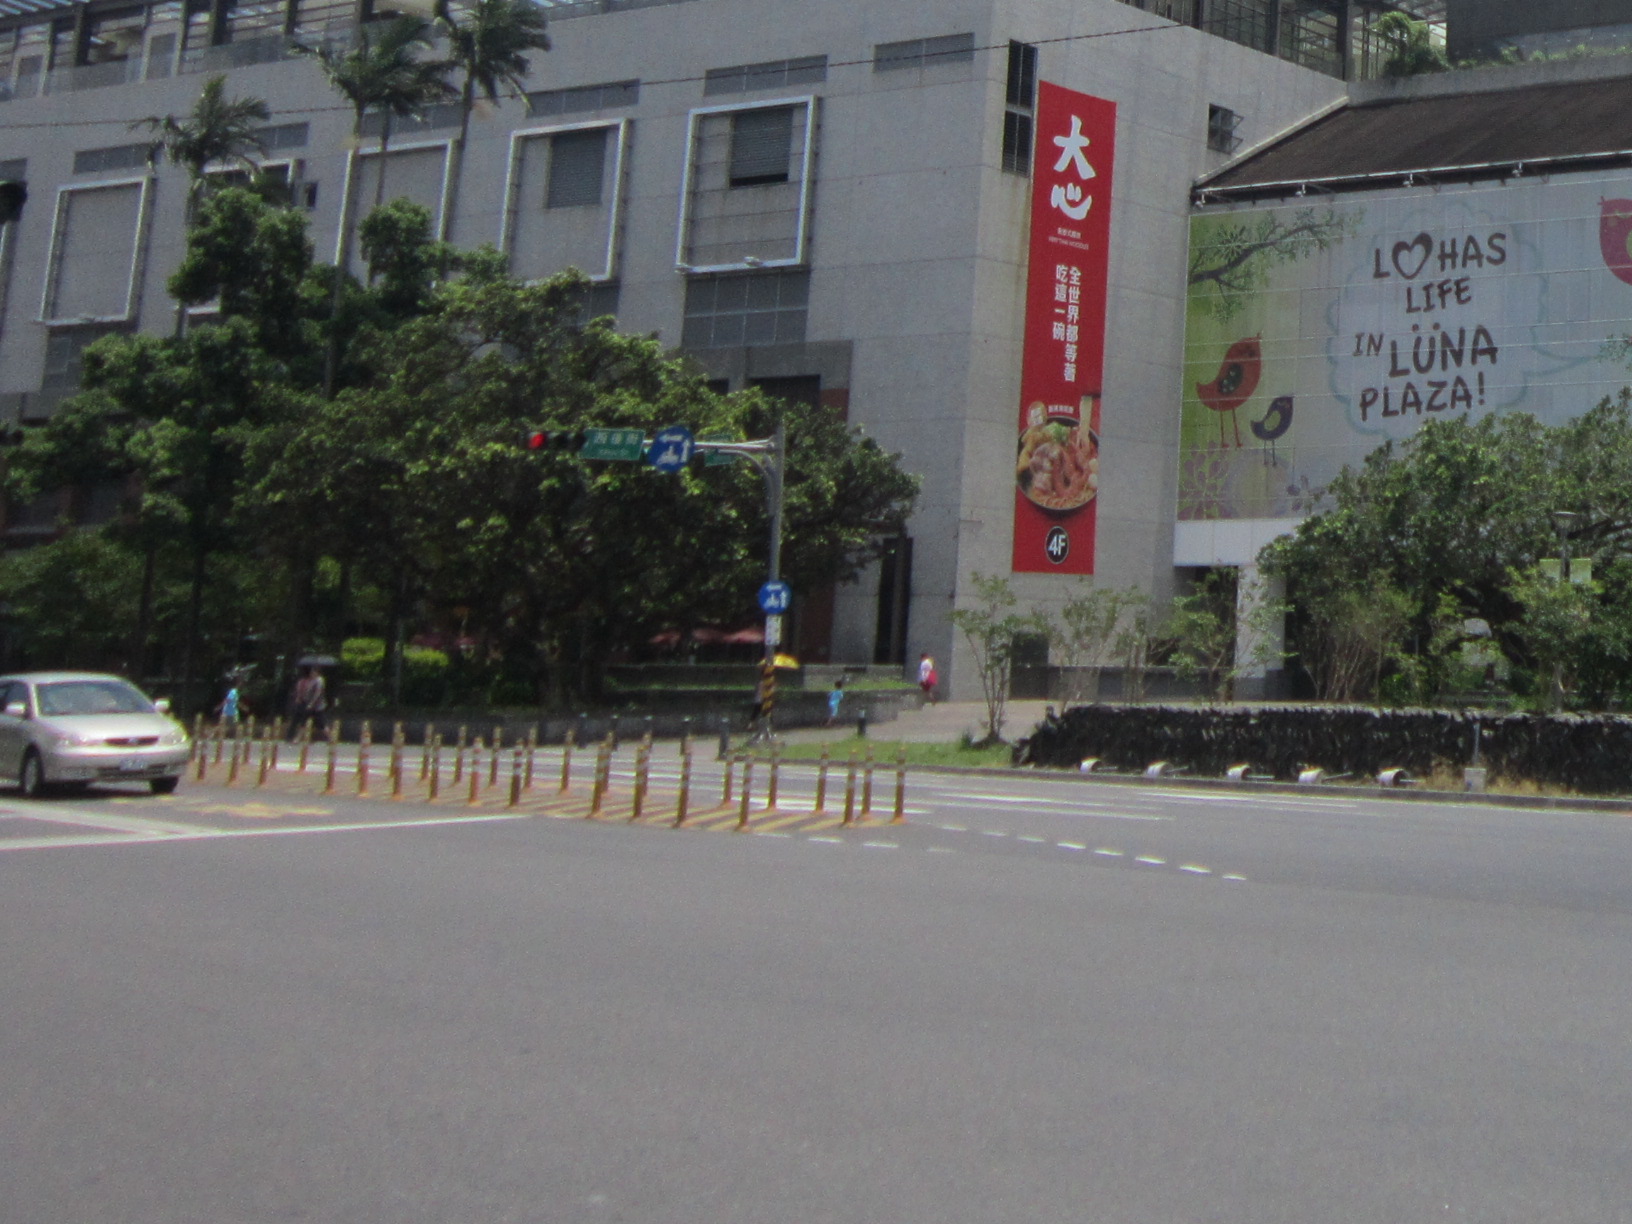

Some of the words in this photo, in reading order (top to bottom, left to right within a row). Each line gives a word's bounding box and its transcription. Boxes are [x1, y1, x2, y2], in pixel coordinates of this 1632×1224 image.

[1050, 114, 1097, 221] 大心
[1052, 264, 1069, 342] 吃這一碗
[1406, 277, 1472, 314] LIFE
[1063, 266, 1082, 383] 全世界都等著
[1353, 332, 1384, 357] IN
[1388, 323, 1499, 378] LÜNA
[1360, 371, 1485, 422] PLAZA!
[1048, 534, 1066, 556] 4F
